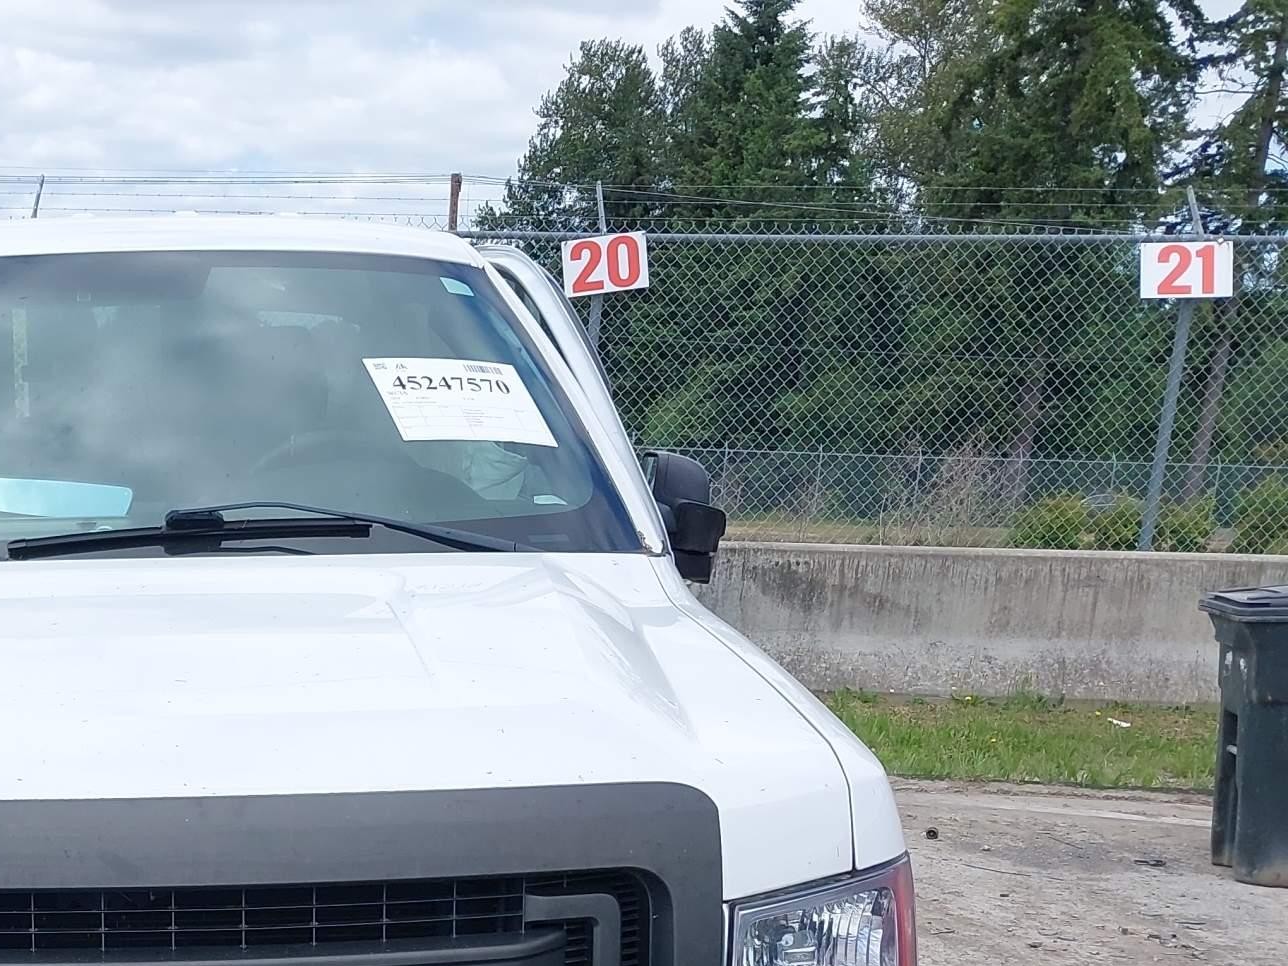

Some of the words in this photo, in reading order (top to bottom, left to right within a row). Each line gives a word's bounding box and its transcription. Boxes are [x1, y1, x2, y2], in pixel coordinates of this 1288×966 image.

[570, 235, 641, 293] 20
[1157, 245, 1215, 295] 21
[392, 375, 511, 395] 45247570
